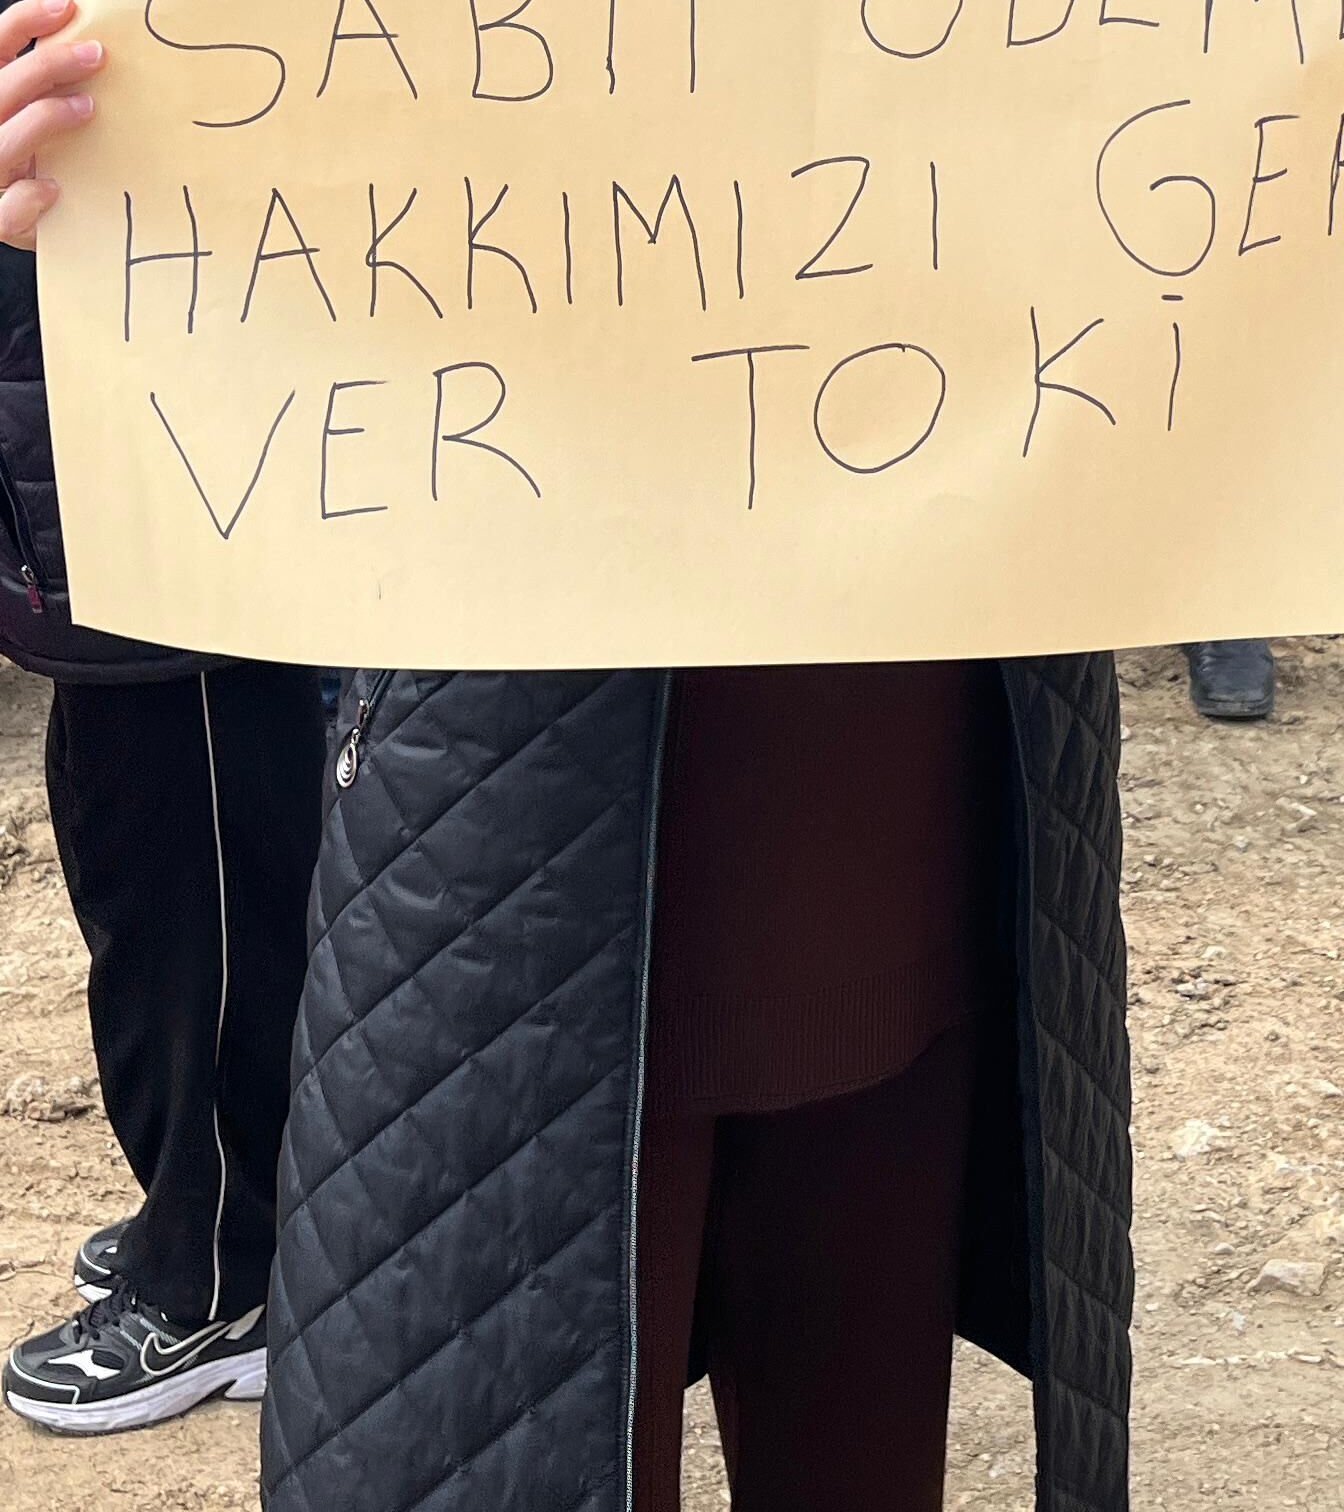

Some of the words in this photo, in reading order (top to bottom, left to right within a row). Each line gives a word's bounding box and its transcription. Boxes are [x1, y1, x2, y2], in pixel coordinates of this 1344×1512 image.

[124, 156, 941, 341] HAKKIMIZI
[150, 362, 541, 540] VER
[691, 294, 1185, 510] TOKİ
